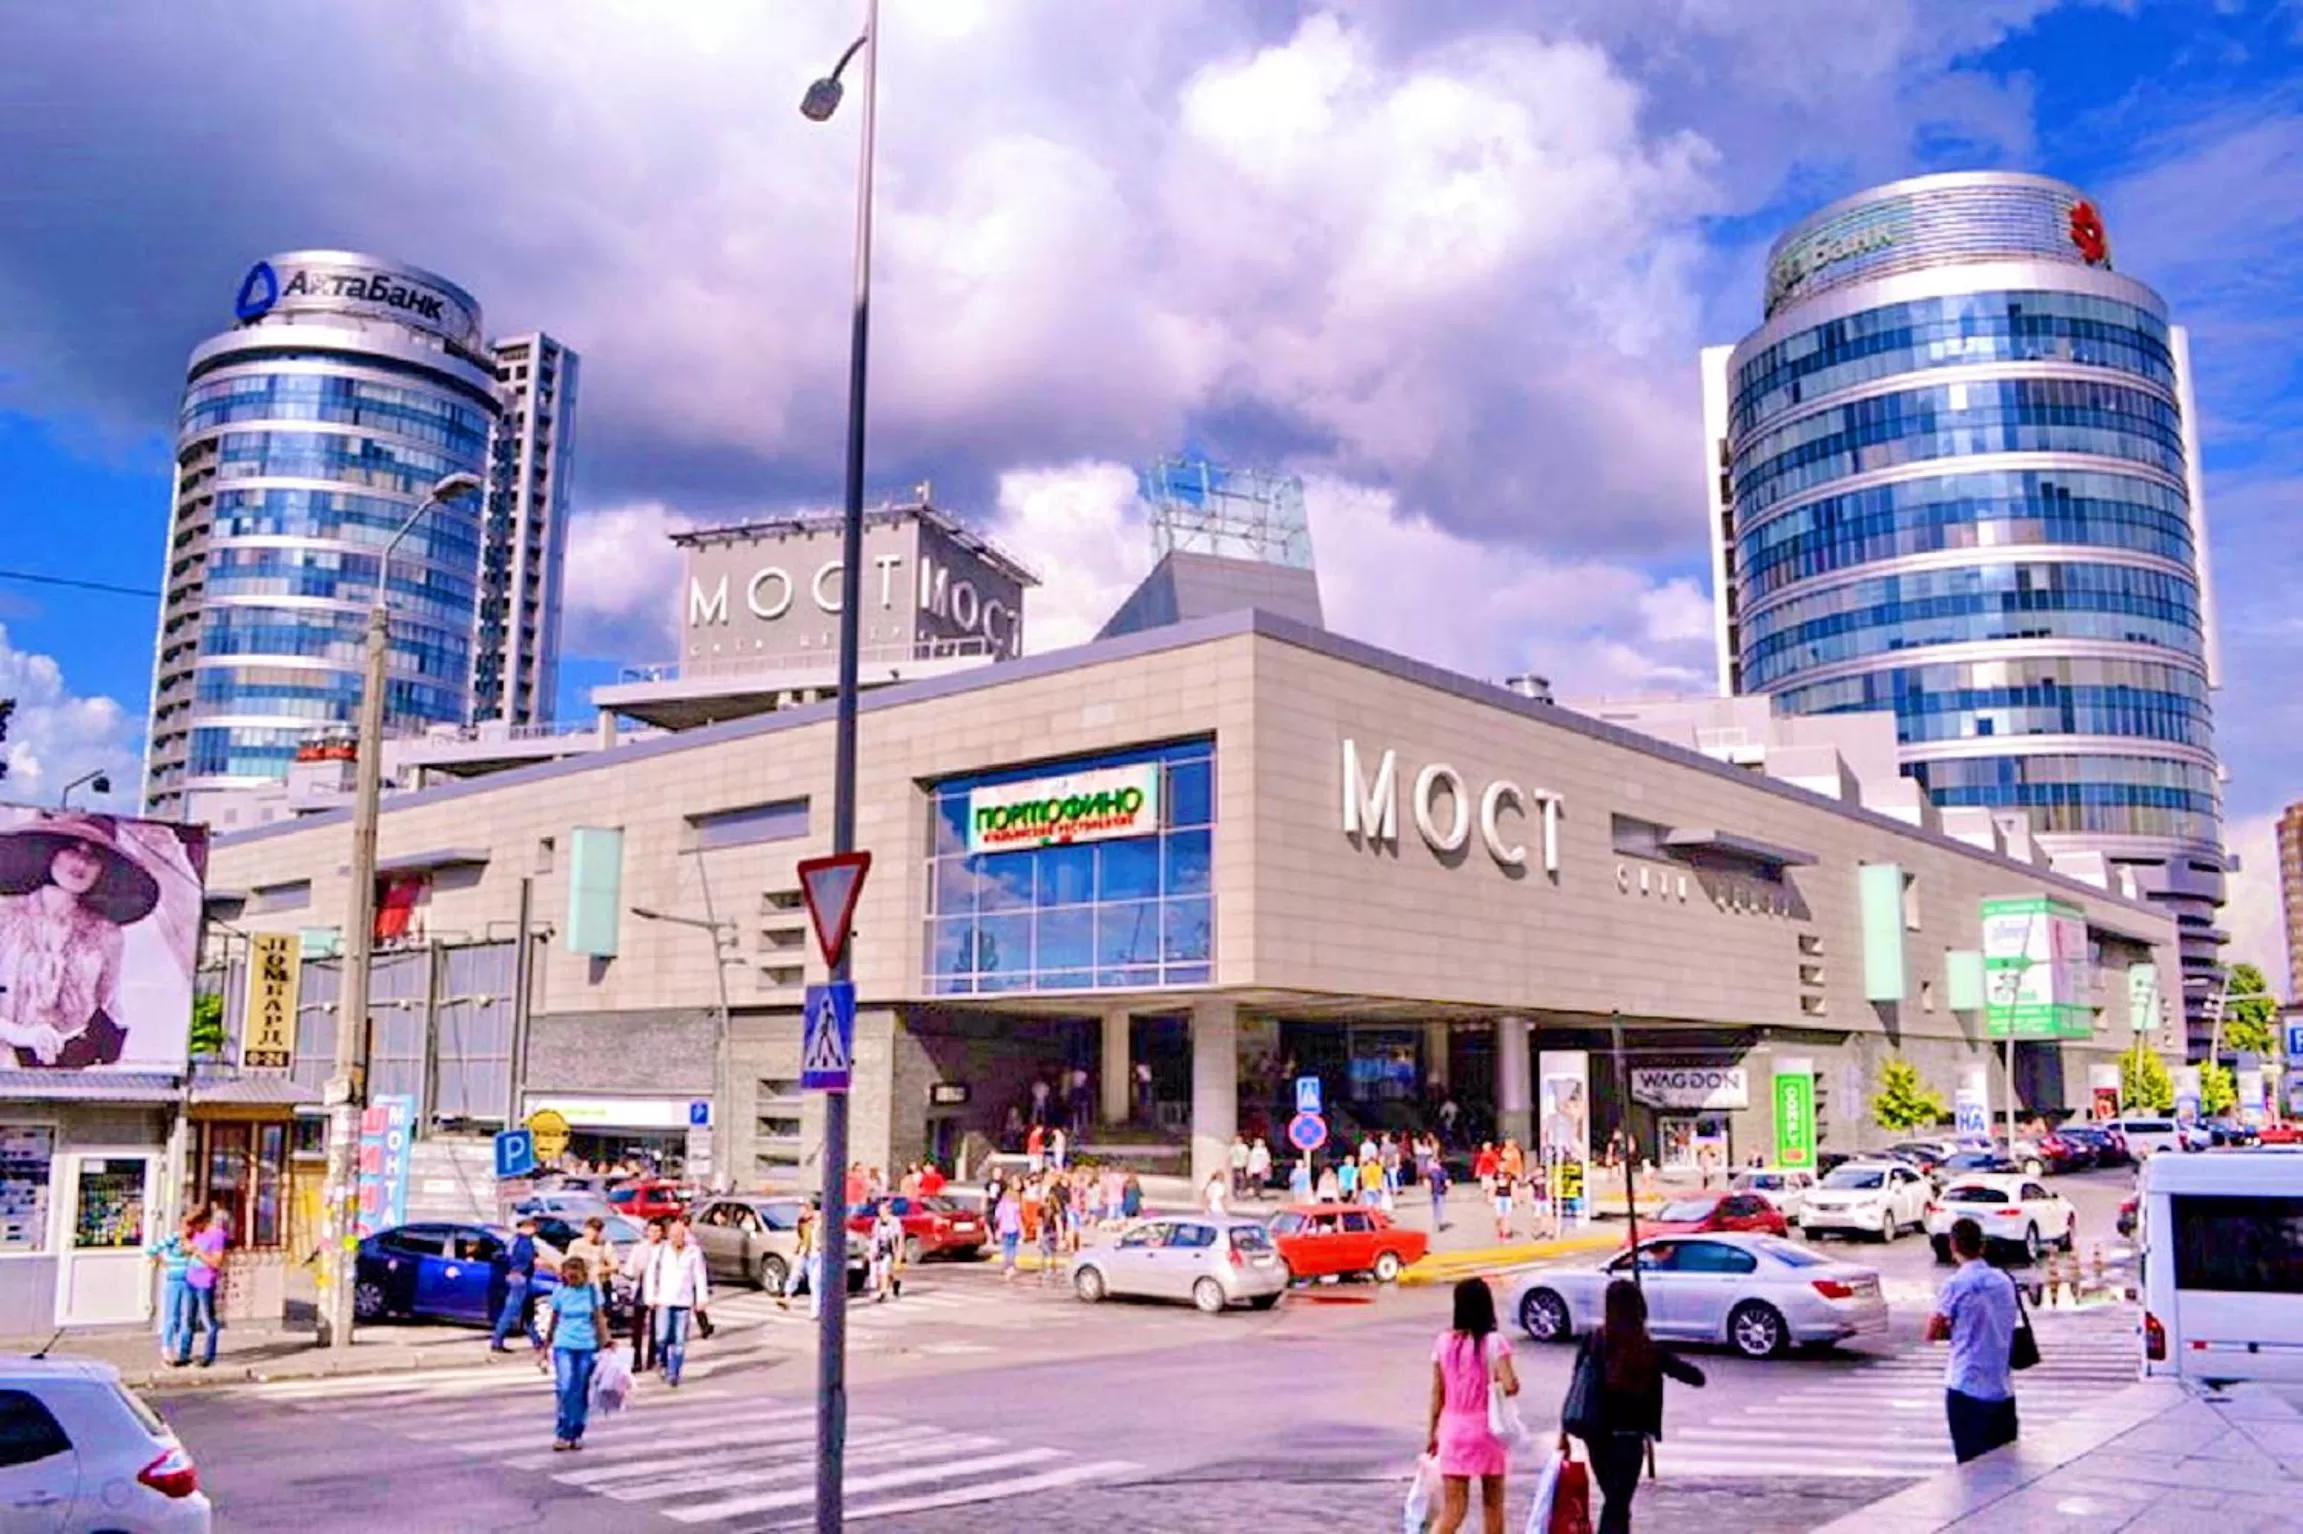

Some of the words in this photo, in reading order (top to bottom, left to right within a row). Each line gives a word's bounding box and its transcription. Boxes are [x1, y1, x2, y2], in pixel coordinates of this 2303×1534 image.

[690, 554, 901, 625] МОСТ
[977, 786, 1143, 834] ПОРТОФИНО
[1343, 739, 1564, 871] МОСТ
[259, 938, 288, 1046] ЛОМБАРД
[505, 1136, 525, 1170] P
